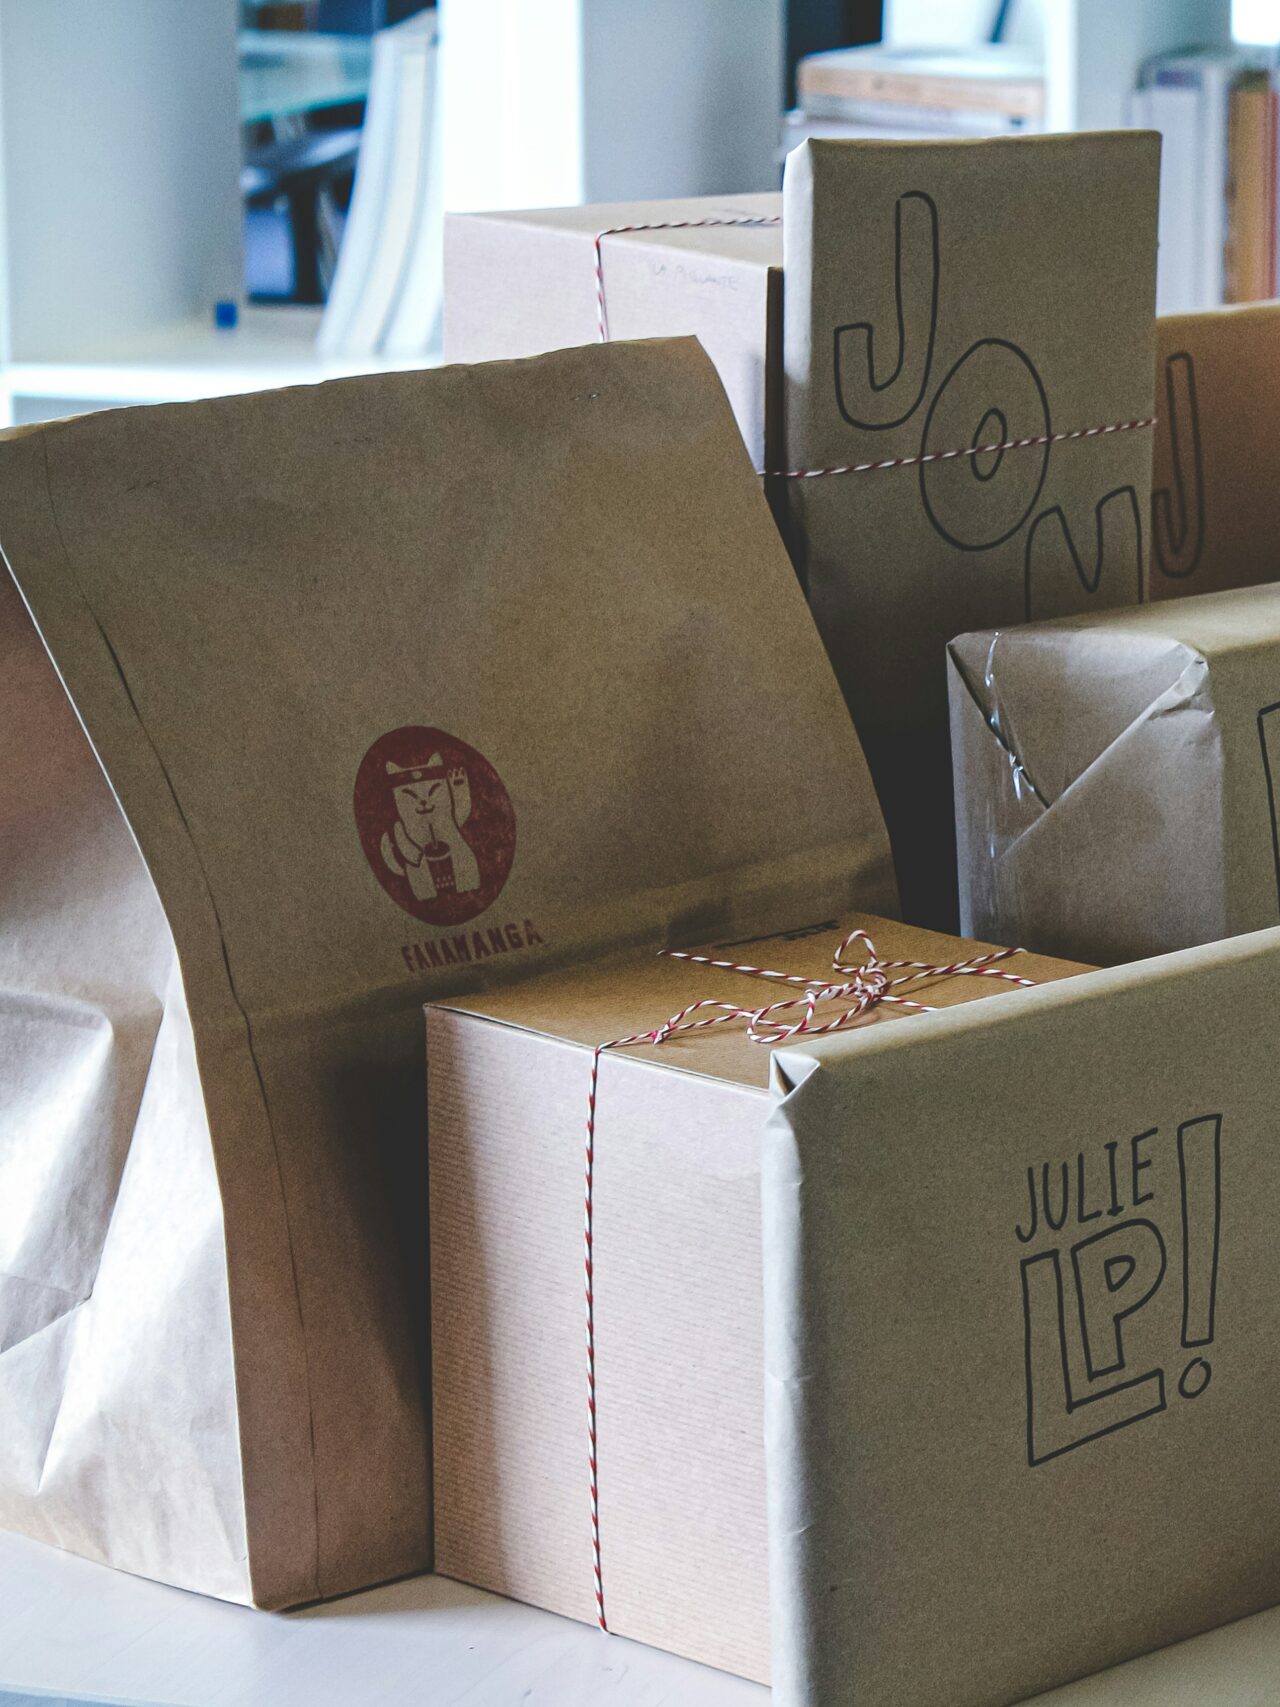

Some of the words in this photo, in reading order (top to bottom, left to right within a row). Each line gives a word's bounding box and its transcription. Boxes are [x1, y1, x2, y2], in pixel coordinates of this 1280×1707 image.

[401, 918, 545, 973] FANAMANGA
[1015, 1127, 1159, 1244] JULIE
[1019, 1113, 1223, 1468] LP!
